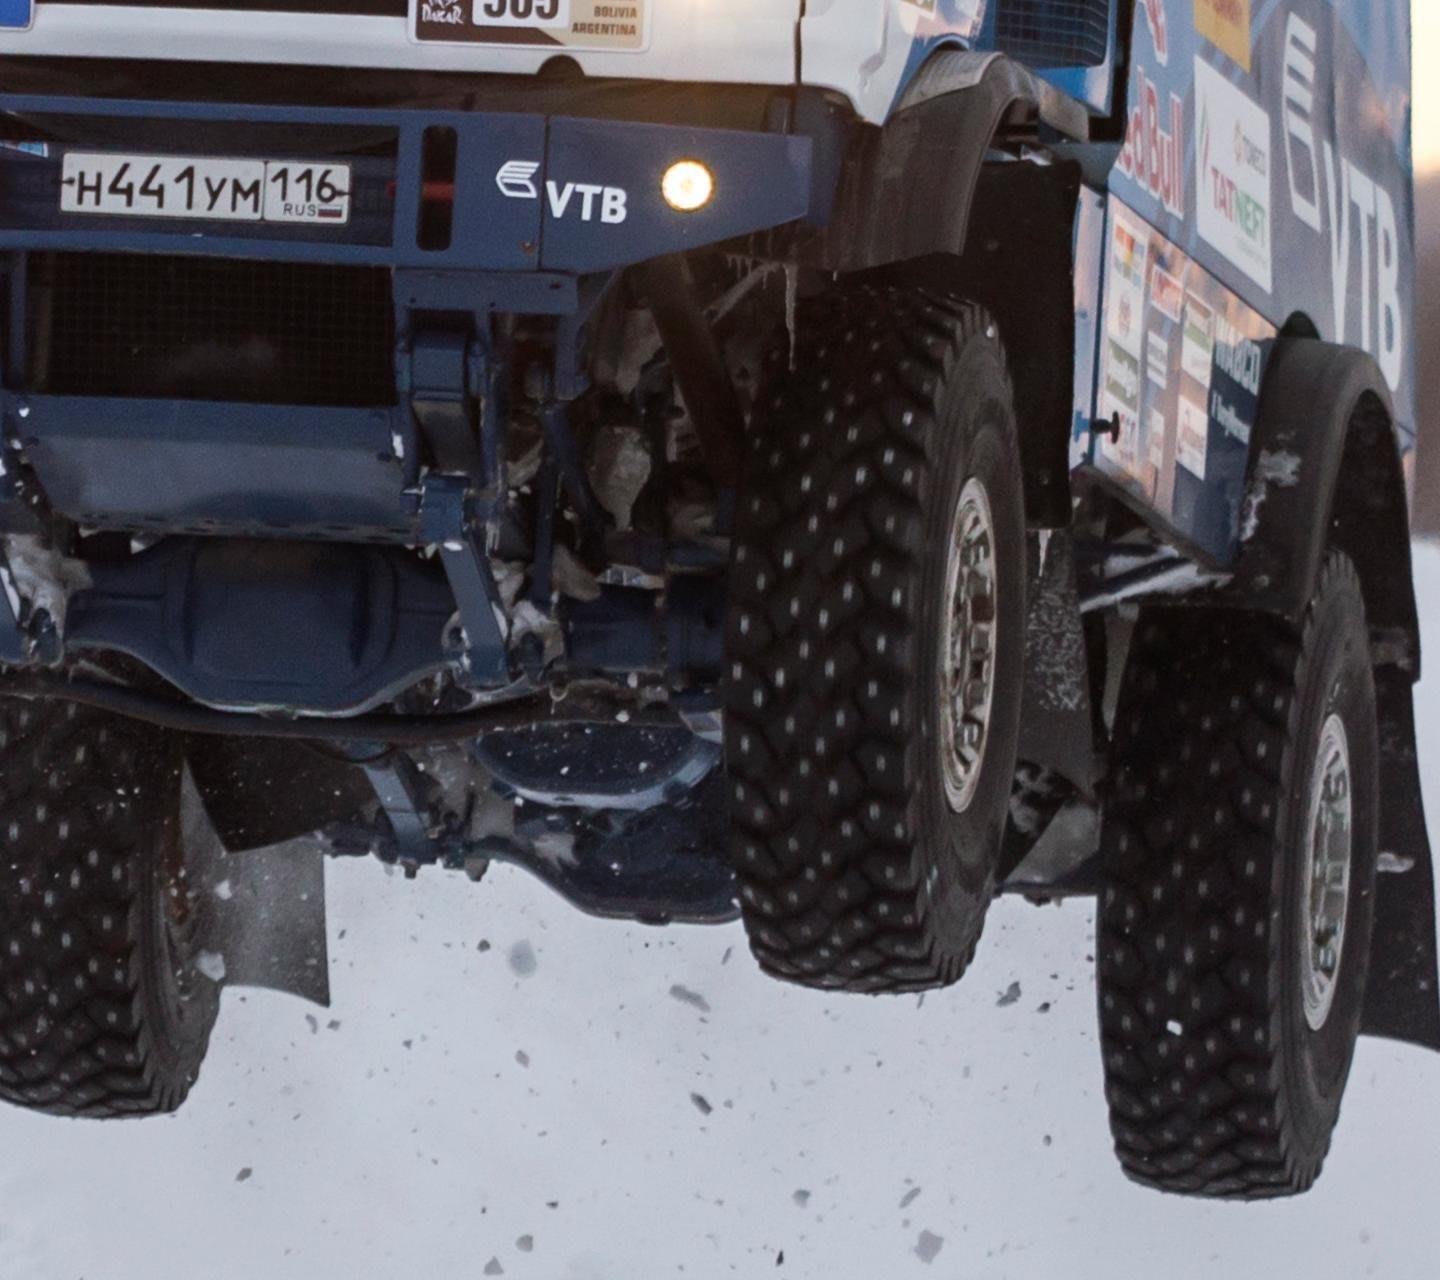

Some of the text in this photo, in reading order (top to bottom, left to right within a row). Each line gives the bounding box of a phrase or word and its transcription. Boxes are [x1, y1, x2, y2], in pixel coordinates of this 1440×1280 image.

[421, 4, 465, 25] DAKAR
[594, 6, 637, 18] BOLIVIA
[572, 22, 636, 36] ARGENTINA
[270, 167, 337, 204] 116
[283, 202, 316, 218] RUS
[545, 180, 627, 225] VTB
[1323, 139, 1403, 393] VTB
